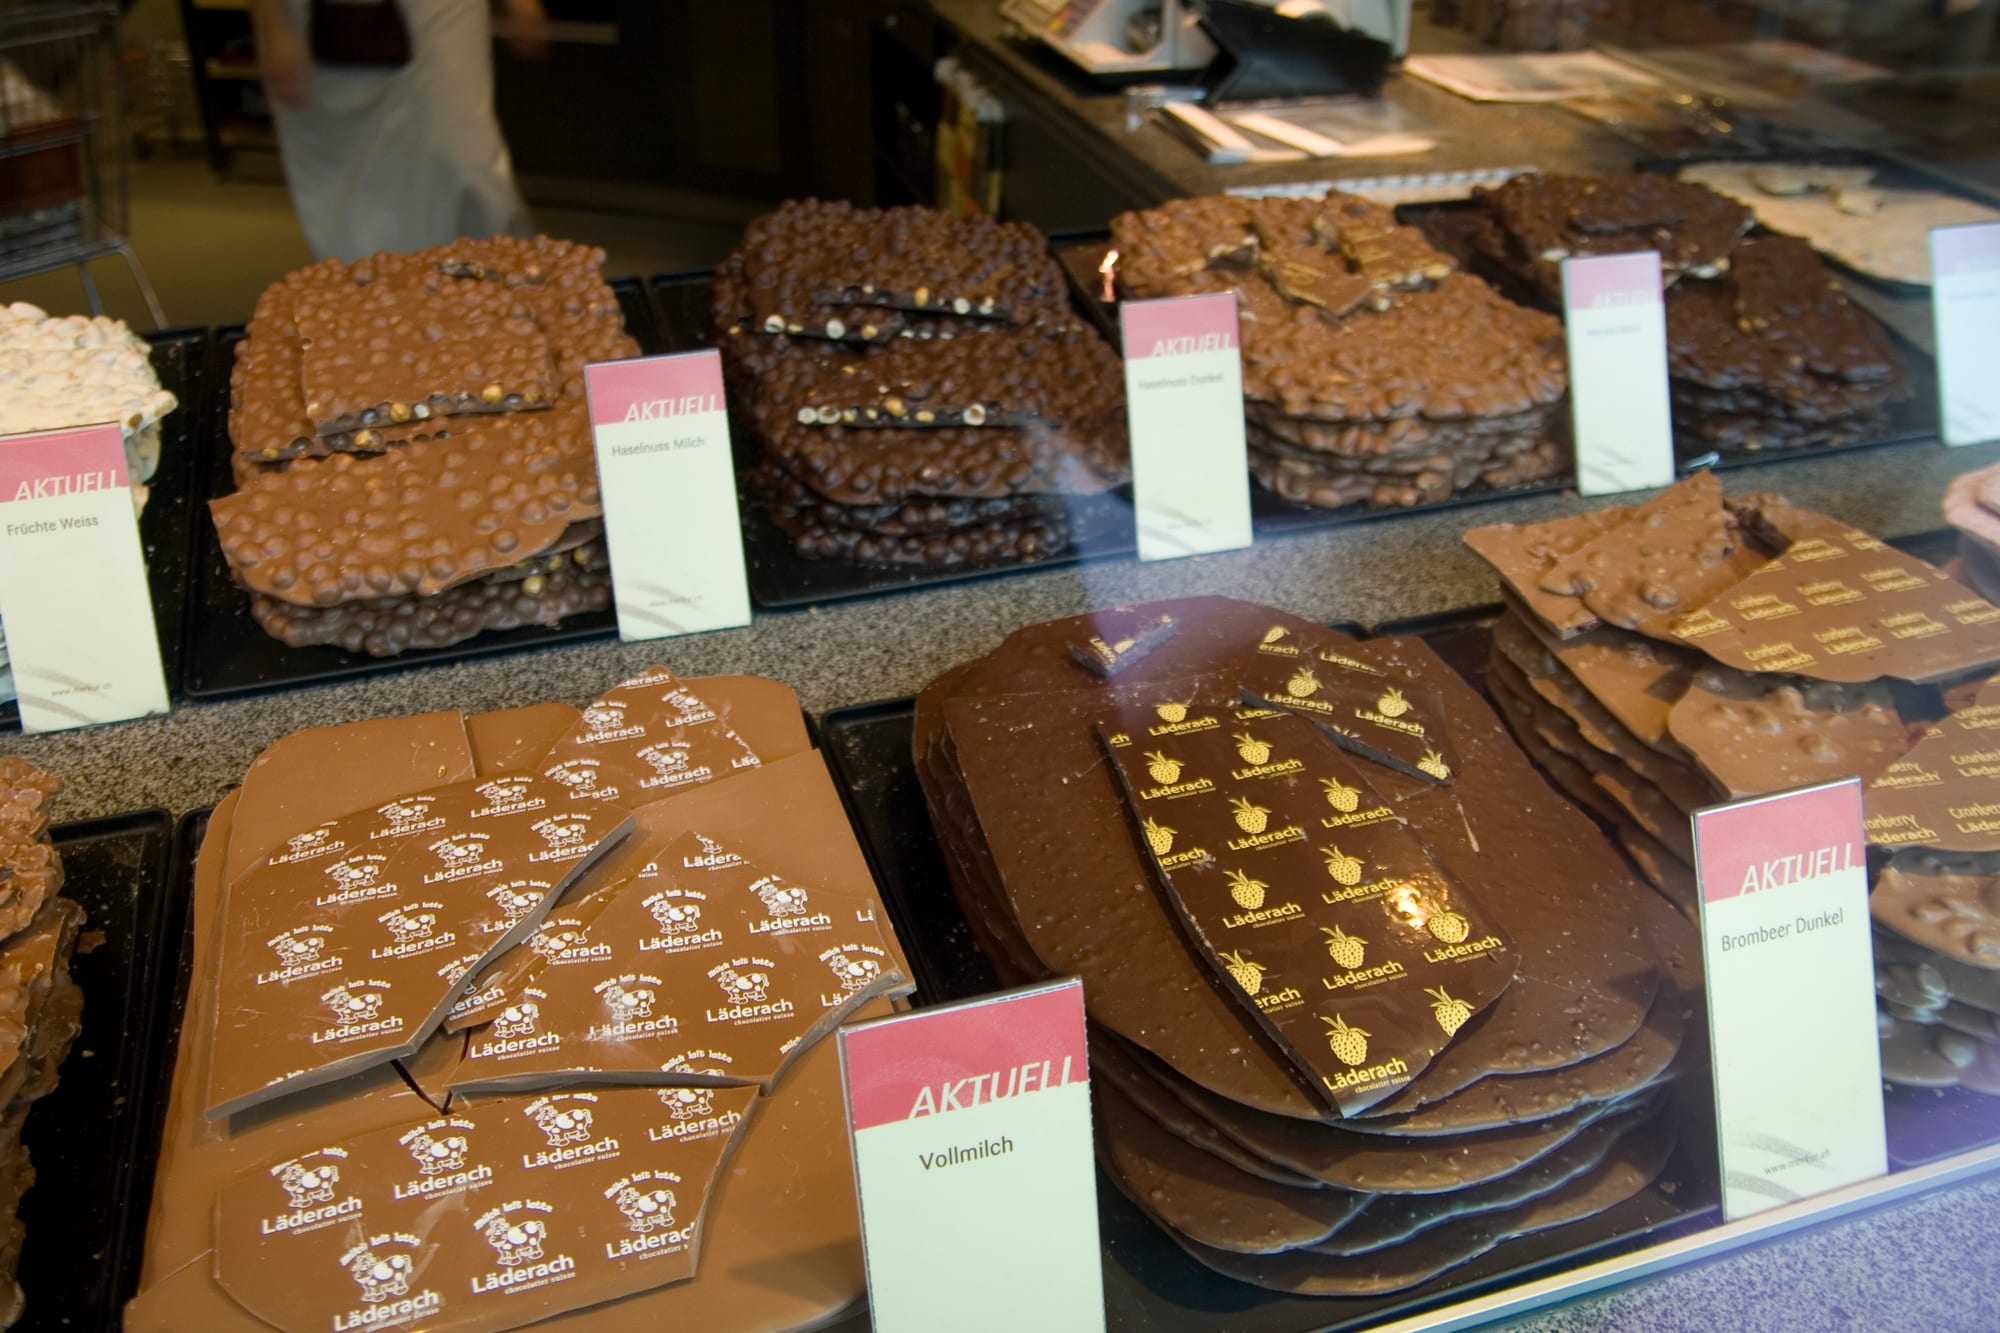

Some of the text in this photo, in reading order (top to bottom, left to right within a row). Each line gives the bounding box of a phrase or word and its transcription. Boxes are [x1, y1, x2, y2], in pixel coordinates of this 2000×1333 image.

[623, 393, 718, 422] AKTUELL
[611, 436, 705, 457] Haselnuss Milch
[14, 469, 119, 502] AKTUELL
[7, 516, 99, 536] Früchte Weiss
[1264, 692, 1334, 711] Läderach
[665, 711, 716, 728] Lädera
[1149, 716, 1218, 737] Läderach
[1354, 709, 1425, 735] Läderach
[575, 725, 645, 745] Läderach
[640, 766, 712, 789] Läderach
[1231, 759, 1303, 780] Läderach
[1140, 778, 1213, 800] Läderach
[470, 798, 545, 818] Läderach
[1320, 806, 1394, 828] Läderach
[370, 816, 446, 839] Läderach
[1228, 826, 1303, 851] Läderach
[268, 840, 345, 865] Läderach
[528, 840, 600, 863] Läderac
[683, 853, 741, 868] Lädera
[423, 858, 503, 884] Läderach
[1739, 843, 1857, 896] AKTUELL
[317, 883, 398, 906] Läderach
[1321, 878, 1398, 905] Läderach
[749, 913, 831, 934] Läderach
[1222, 902, 1302, 929] Läderach
[639, 929, 723, 951] Läderach
[1721, 907, 1844, 952] Brombeer Dunkel
[372, 932, 456, 959] Läderach
[1423, 935, 1503, 964] Läderach
[257, 956, 343, 984] Läderach
[1322, 960, 1404, 990] Läderach
[706, 999, 794, 1023] Läderach
[312, 1016, 403, 1044] Läderach
[590, 1015, 678, 1040] Läderach
[471, 1031, 560, 1058] Läderach
[1322, 1057, 1408, 1091] Läderach
[908, 1056, 1073, 1120] AKTUELL
[649, 1110, 742, 1142] Läderach
[523, 1136, 619, 1169] Läderach
[554, 1151, 620, 1170] chocolatier suisse
[919, 1136, 1014, 1171] Vollmilch
[394, 1164, 493, 1200] Läderach
[262, 1196, 363, 1235] Läderach
[606, 1222, 694, 1259] Läderac
[472, 1254, 575, 1293] Läderach
[504, 1272, 576, 1295] chocolatier suisse
[333, 1288, 440, 1332] Läderach
